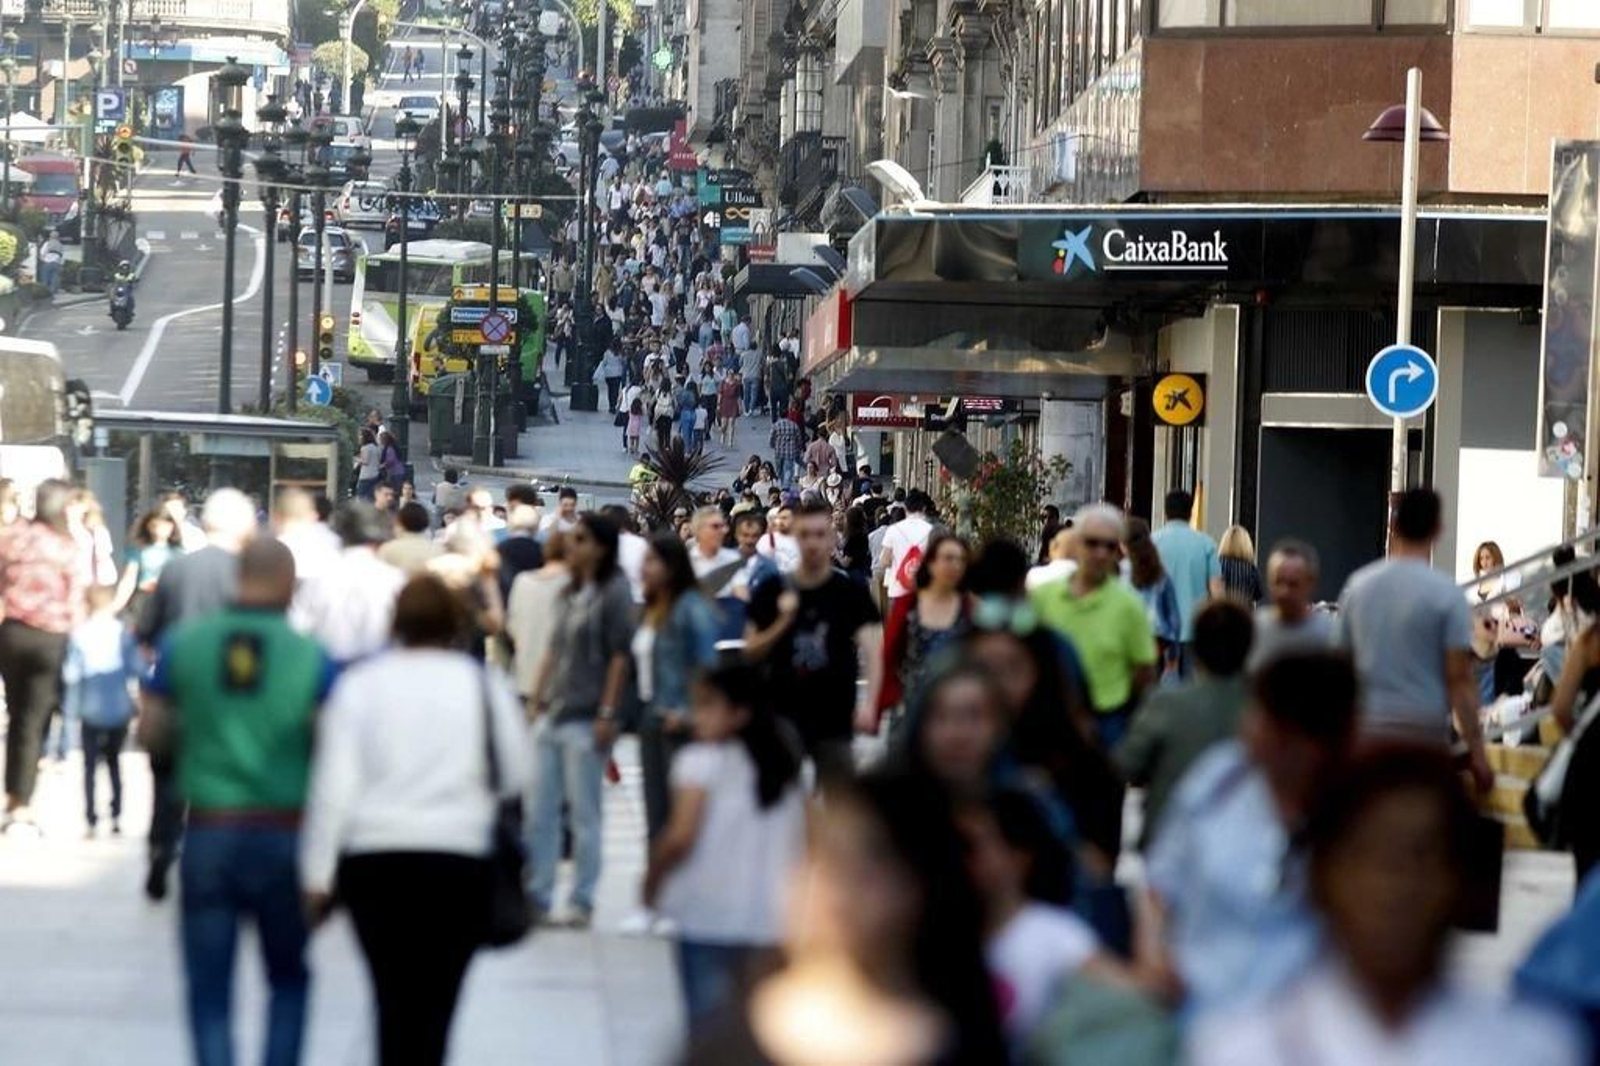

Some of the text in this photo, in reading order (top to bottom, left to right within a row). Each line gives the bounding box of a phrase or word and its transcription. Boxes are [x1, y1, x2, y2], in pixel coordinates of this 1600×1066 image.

[97, 93, 119, 118] P
[724, 191, 755, 203] Ulloa
[1103, 229, 1229, 262] CaixaBank
